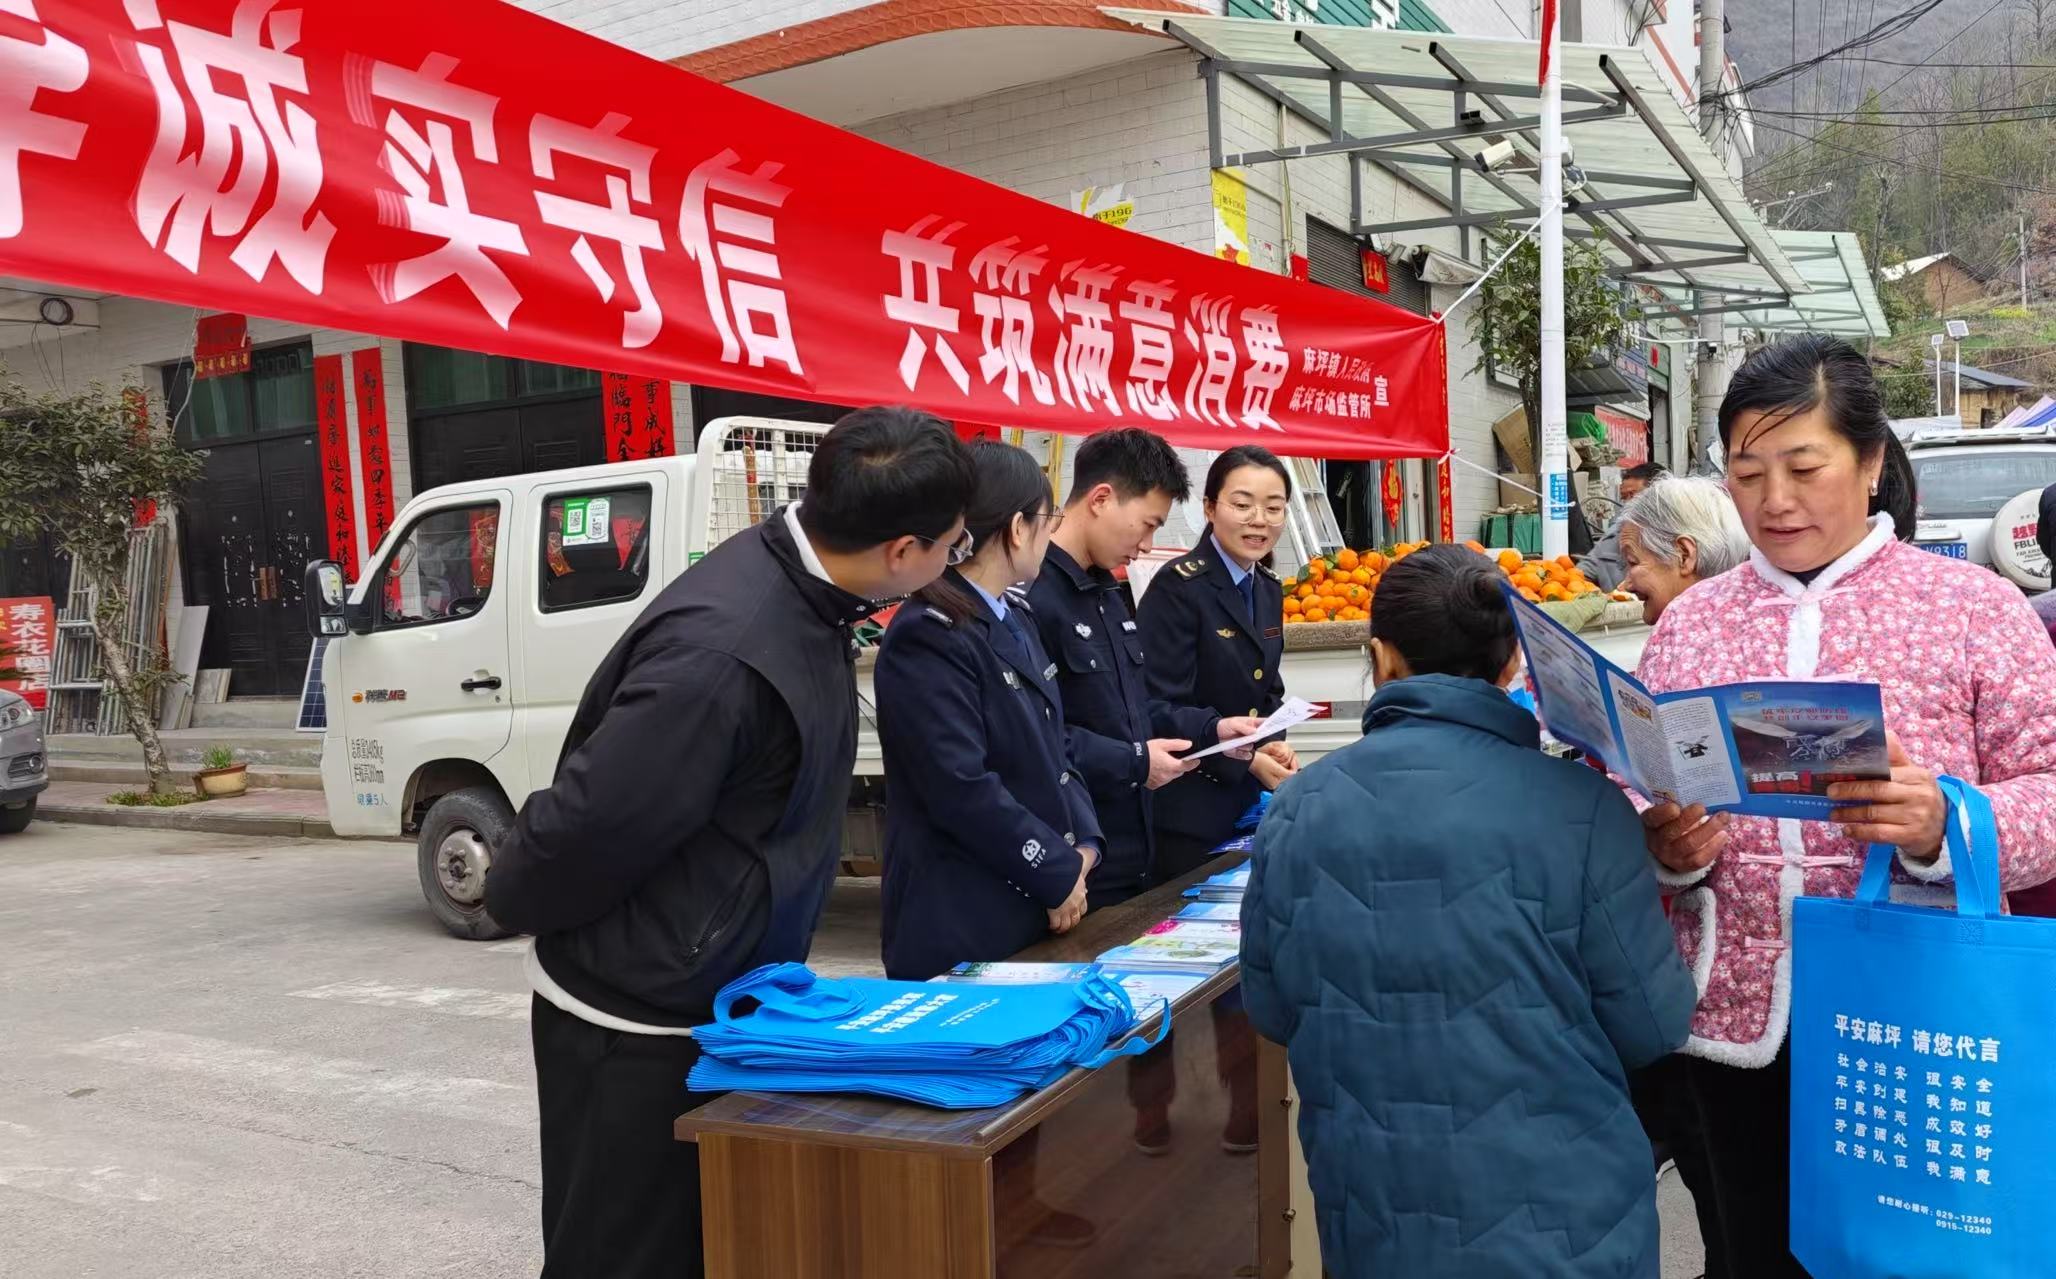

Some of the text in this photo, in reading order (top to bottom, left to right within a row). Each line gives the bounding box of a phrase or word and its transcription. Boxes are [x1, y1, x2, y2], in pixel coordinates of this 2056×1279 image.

[880, 213, 1290, 433] 共筑满意消费
[1288, 384, 1372, 419] 麻坪市场监管所
[1373, 374, 1390, 407] 宣
[1834, 1013, 2001, 1063] 平安麻坪 请您代言
[1837, 1052, 1993, 1093] 社会治安 很安全
[1834, 1096, 1993, 1139] 扫黑除恶 成效好
[1835, 1074, 1993, 1118] 平安创建 我知道
[1835, 1118, 1993, 1162] 矛盾调处 很及时
[1835, 1140, 1993, 1185] 政法队伍 我满意
[1936, 1219, 1993, 1235] 0915-12340
